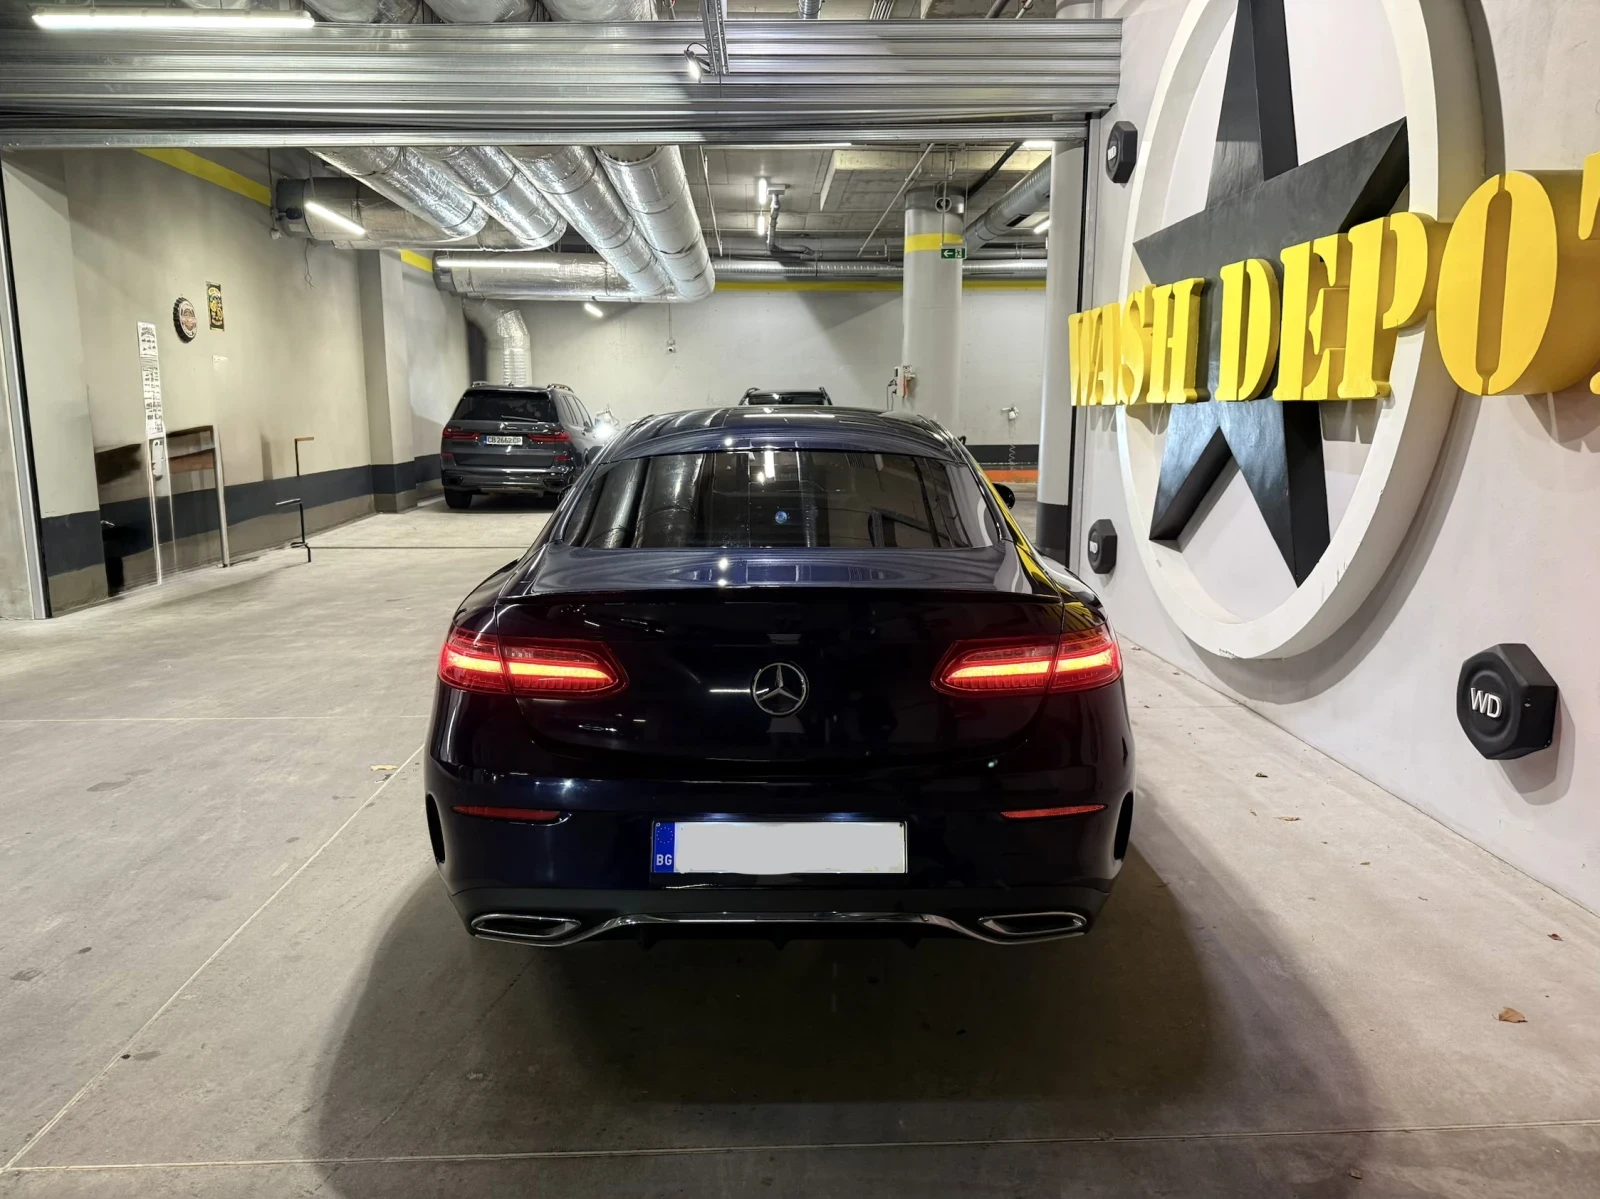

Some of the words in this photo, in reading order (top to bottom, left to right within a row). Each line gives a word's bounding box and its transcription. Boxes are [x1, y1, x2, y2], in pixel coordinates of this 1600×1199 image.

[1068, 278, 1205, 406] WASH
[1470, 687, 1502, 718] WD
[656, 854, 673, 866] BG
